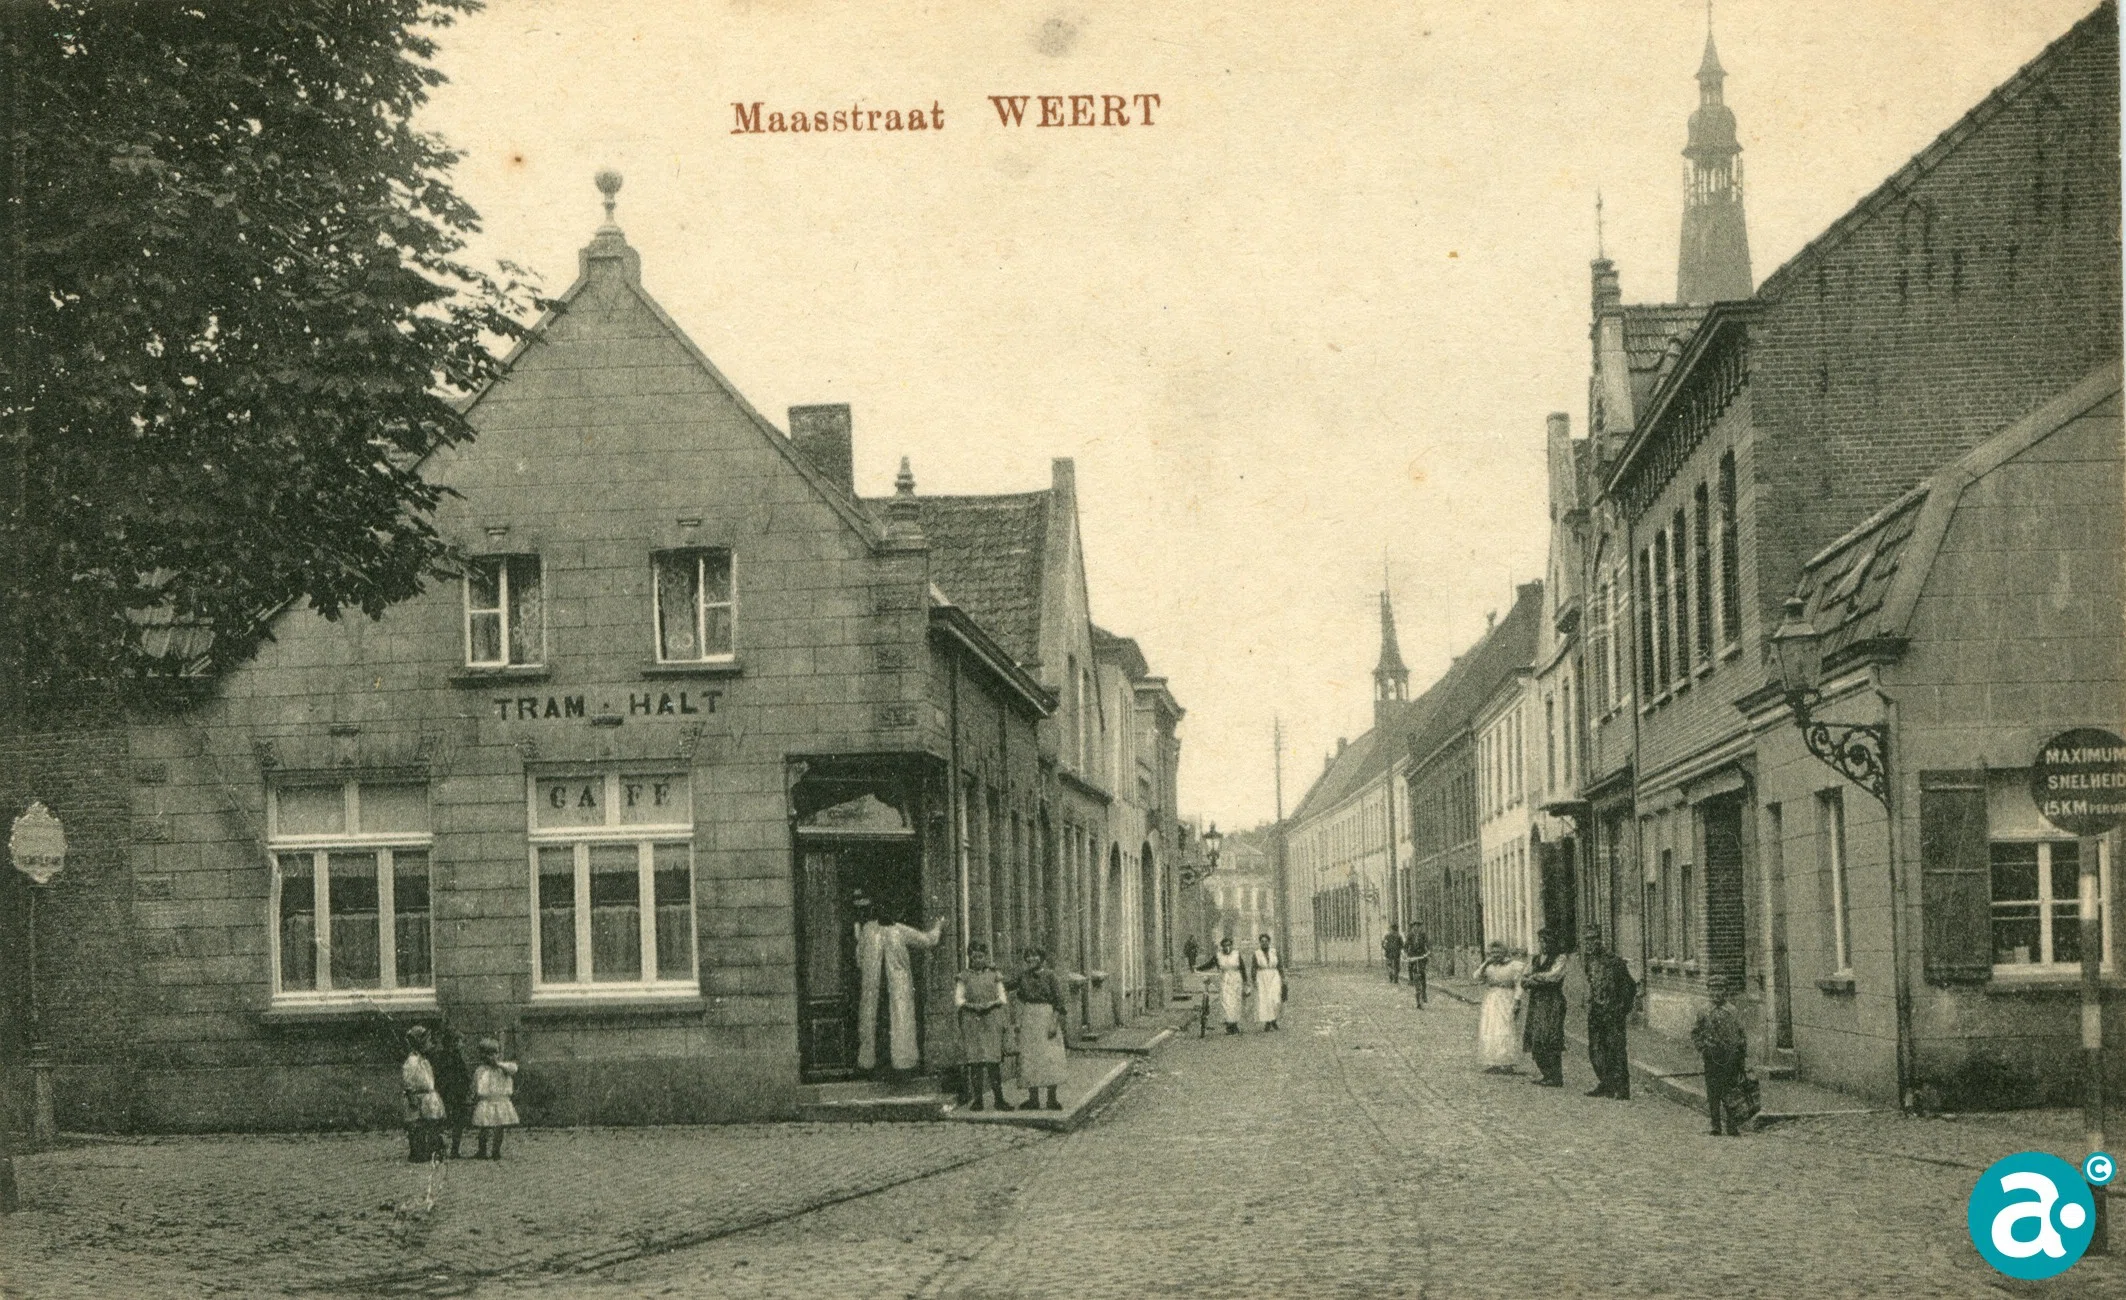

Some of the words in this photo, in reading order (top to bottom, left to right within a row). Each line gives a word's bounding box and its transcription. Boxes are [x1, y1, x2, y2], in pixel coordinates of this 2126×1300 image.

[494, 696, 585, 720] TRAM
[630, 690, 723, 715] HALT
[2045, 747, 2126, 764] MAXIMUM
[2047, 772, 2126, 789] SNELHEID
